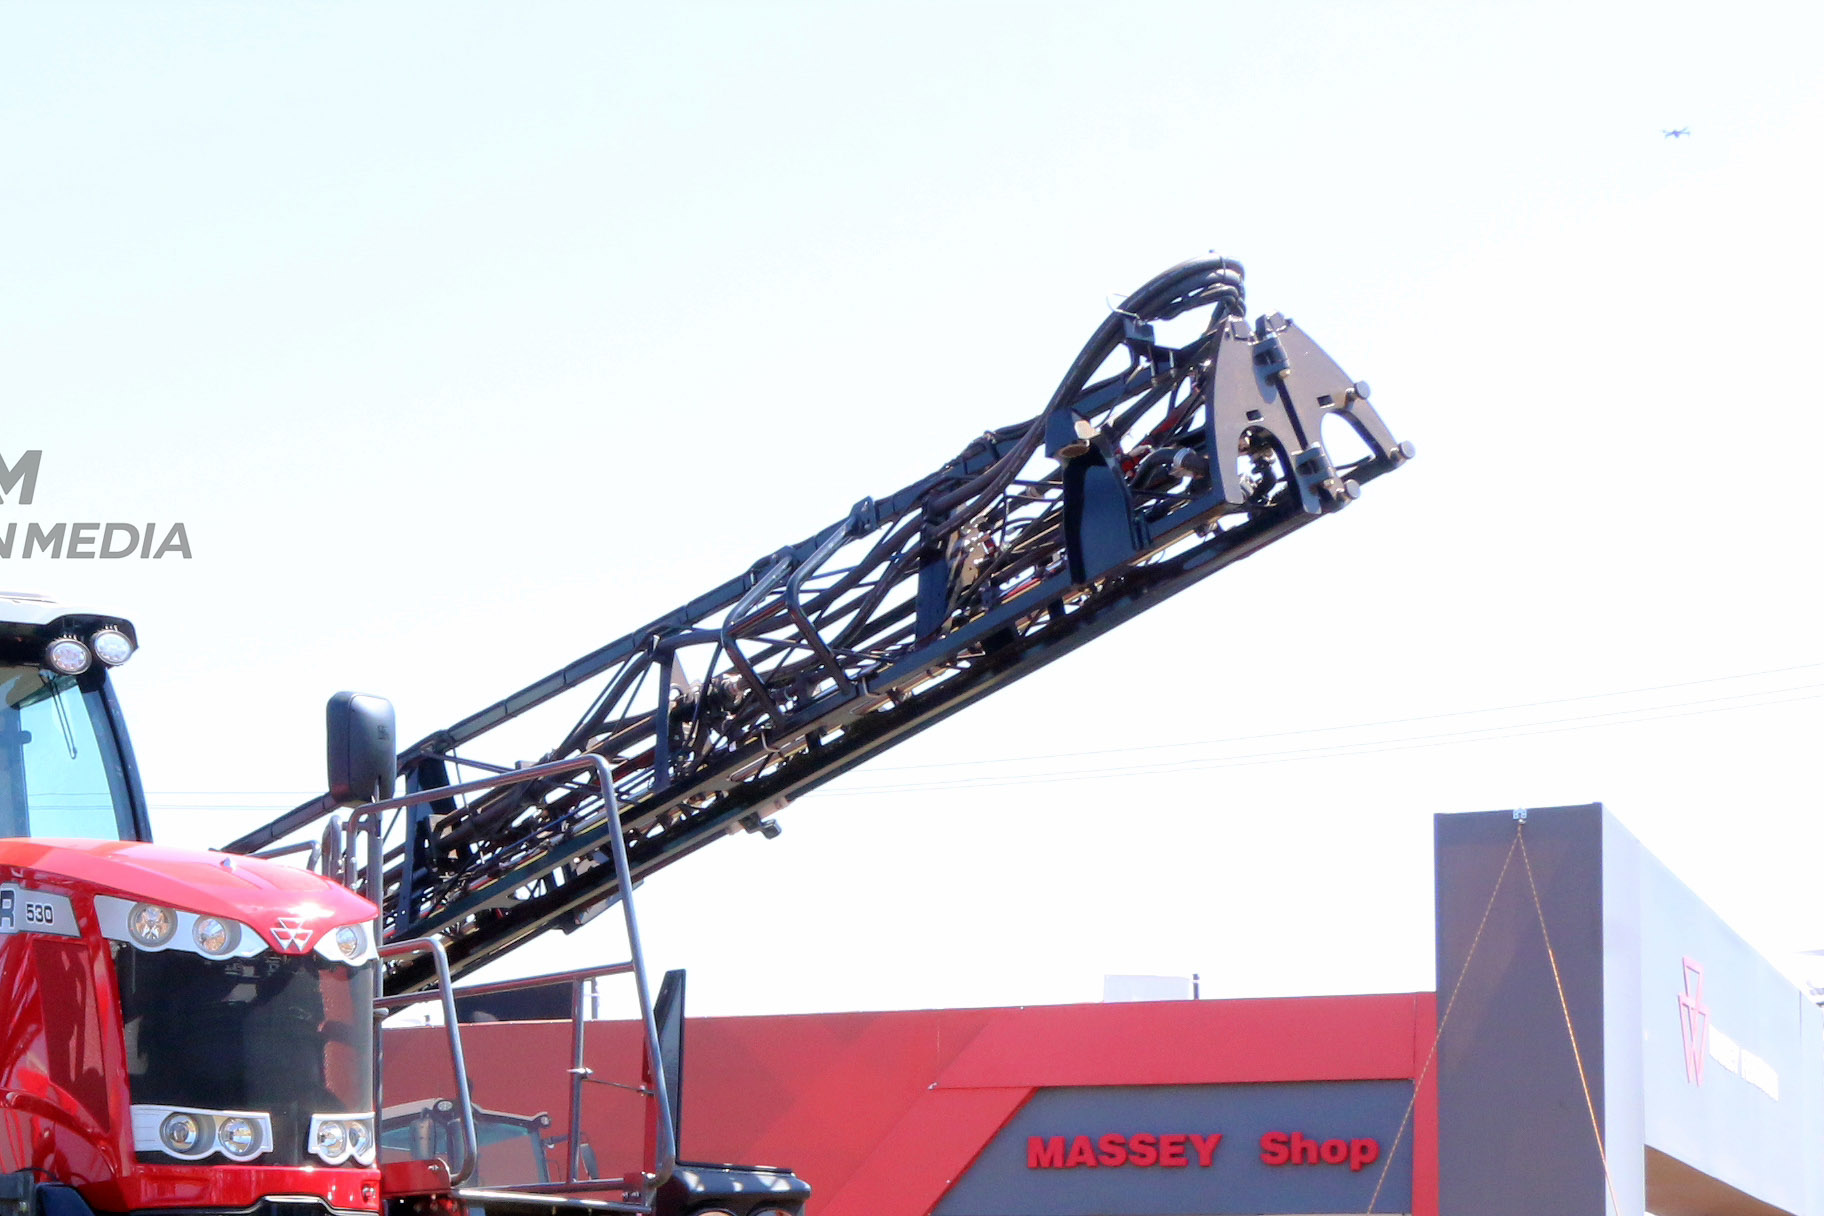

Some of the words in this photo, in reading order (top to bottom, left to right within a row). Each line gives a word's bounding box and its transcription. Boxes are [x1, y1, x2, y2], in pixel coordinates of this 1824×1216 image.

[25, 902, 54, 926] 530
[1026, 1133, 1223, 1169] MASSEY
[1259, 1131, 1380, 1171] Shop
